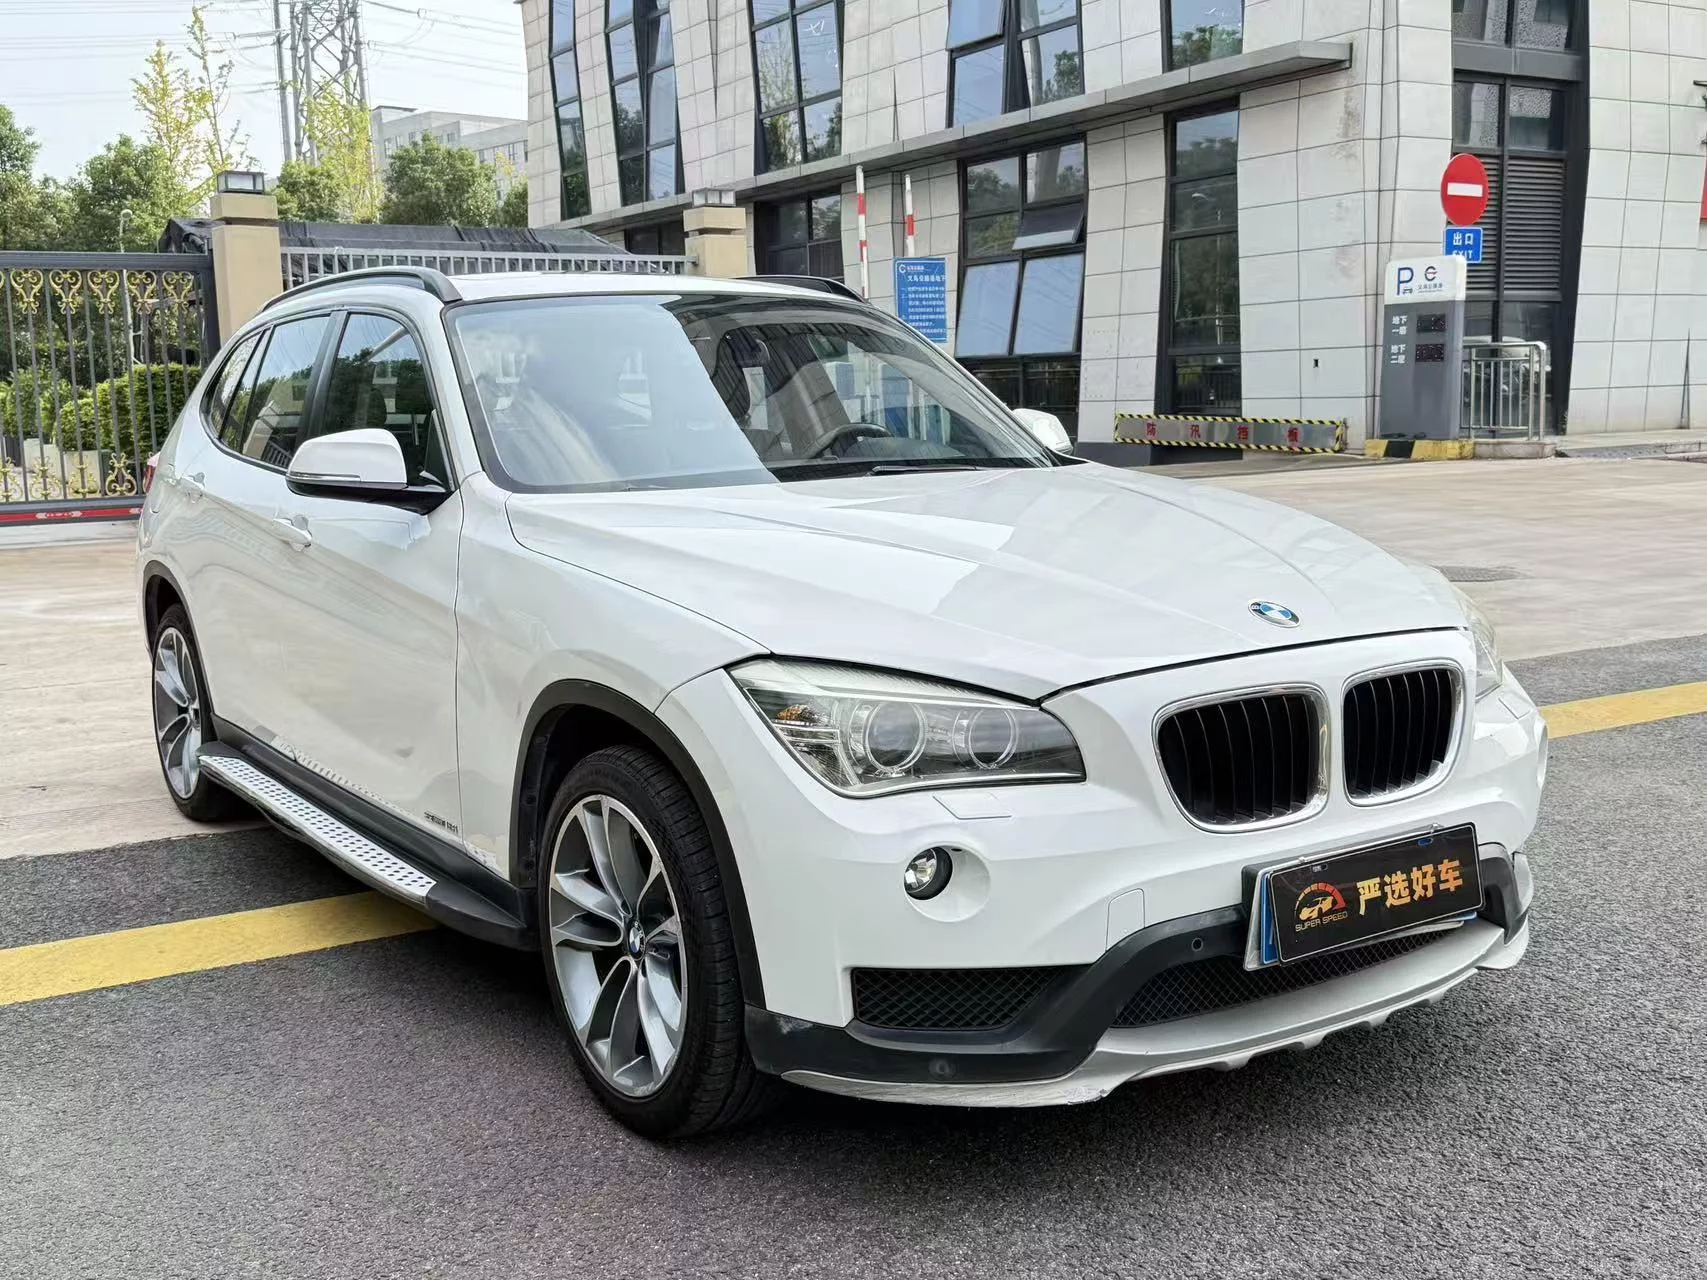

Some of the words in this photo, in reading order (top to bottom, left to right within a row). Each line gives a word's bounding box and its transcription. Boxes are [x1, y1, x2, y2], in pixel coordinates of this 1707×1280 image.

[1453, 232, 1474, 245] 出口
[1396, 266, 1414, 295] P
[1356, 859, 1463, 916] 严选好车
[1295, 918, 1321, 932] SUPER
[1322, 911, 1348, 924] SPEED
